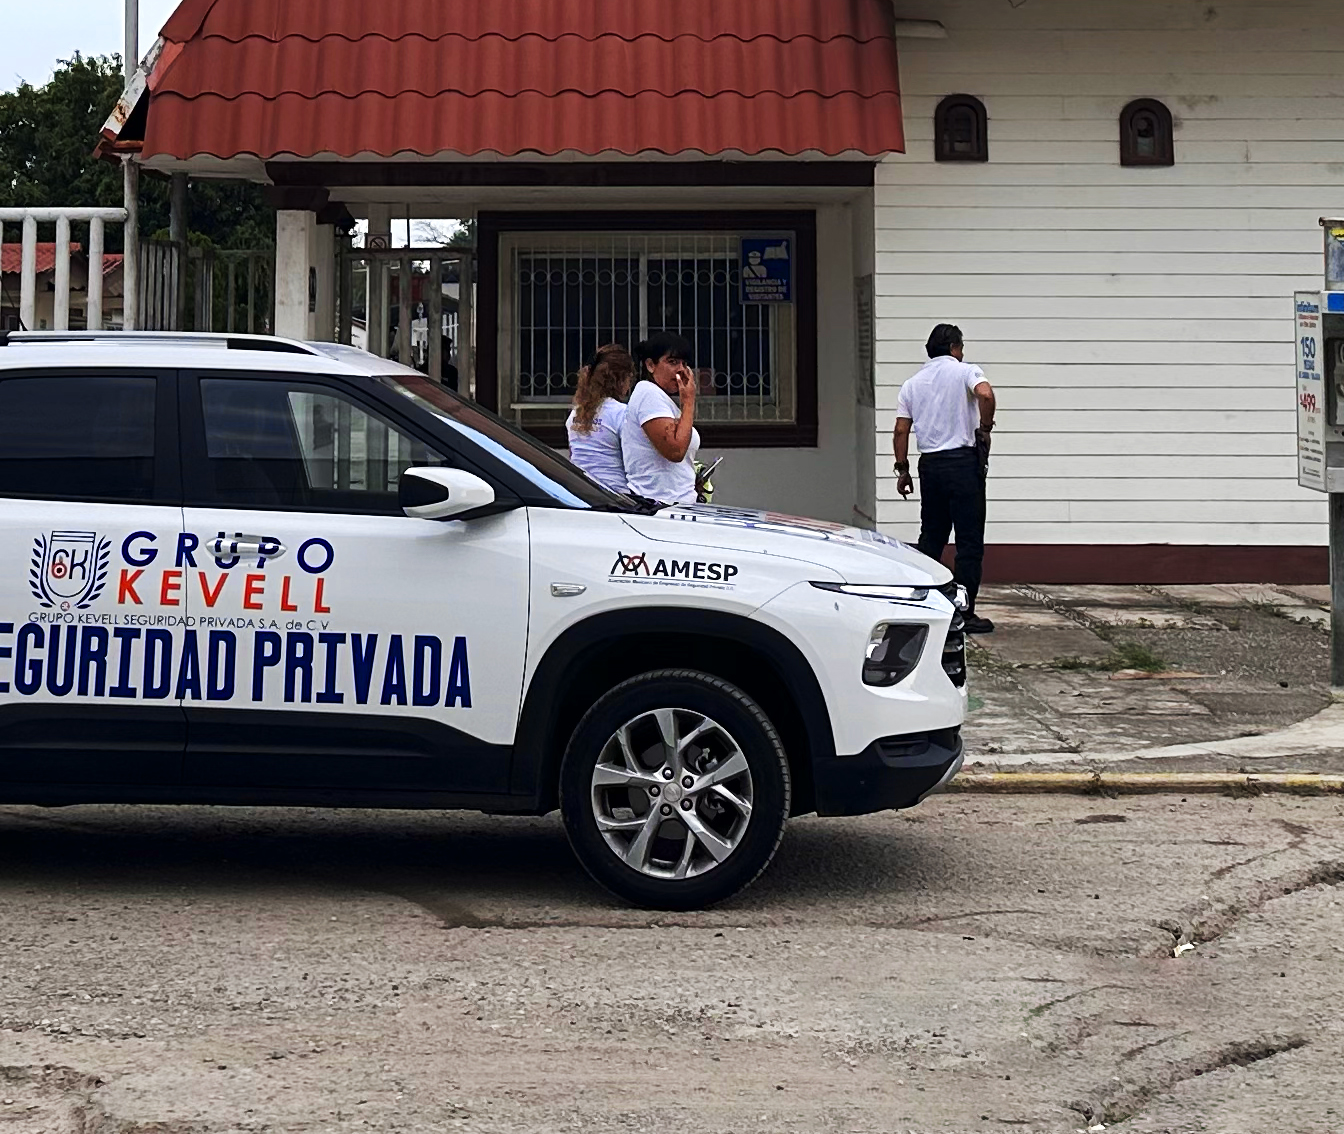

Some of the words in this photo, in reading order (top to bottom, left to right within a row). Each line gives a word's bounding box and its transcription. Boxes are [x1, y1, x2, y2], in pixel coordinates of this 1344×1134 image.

[120, 530, 335, 575] GRUPO
[652, 559, 738, 582] AMESP
[117, 568, 331, 614] KEVELL
[28, 612, 74, 624] GRUPO
[78, 613, 120, 625] KEVELL
[123, 615, 195, 627] SEGURIDAD
[199, 617, 255, 629] PRIVADA
[285, 619, 303, 630] de
[252, 630, 473, 709] PRIVADA
